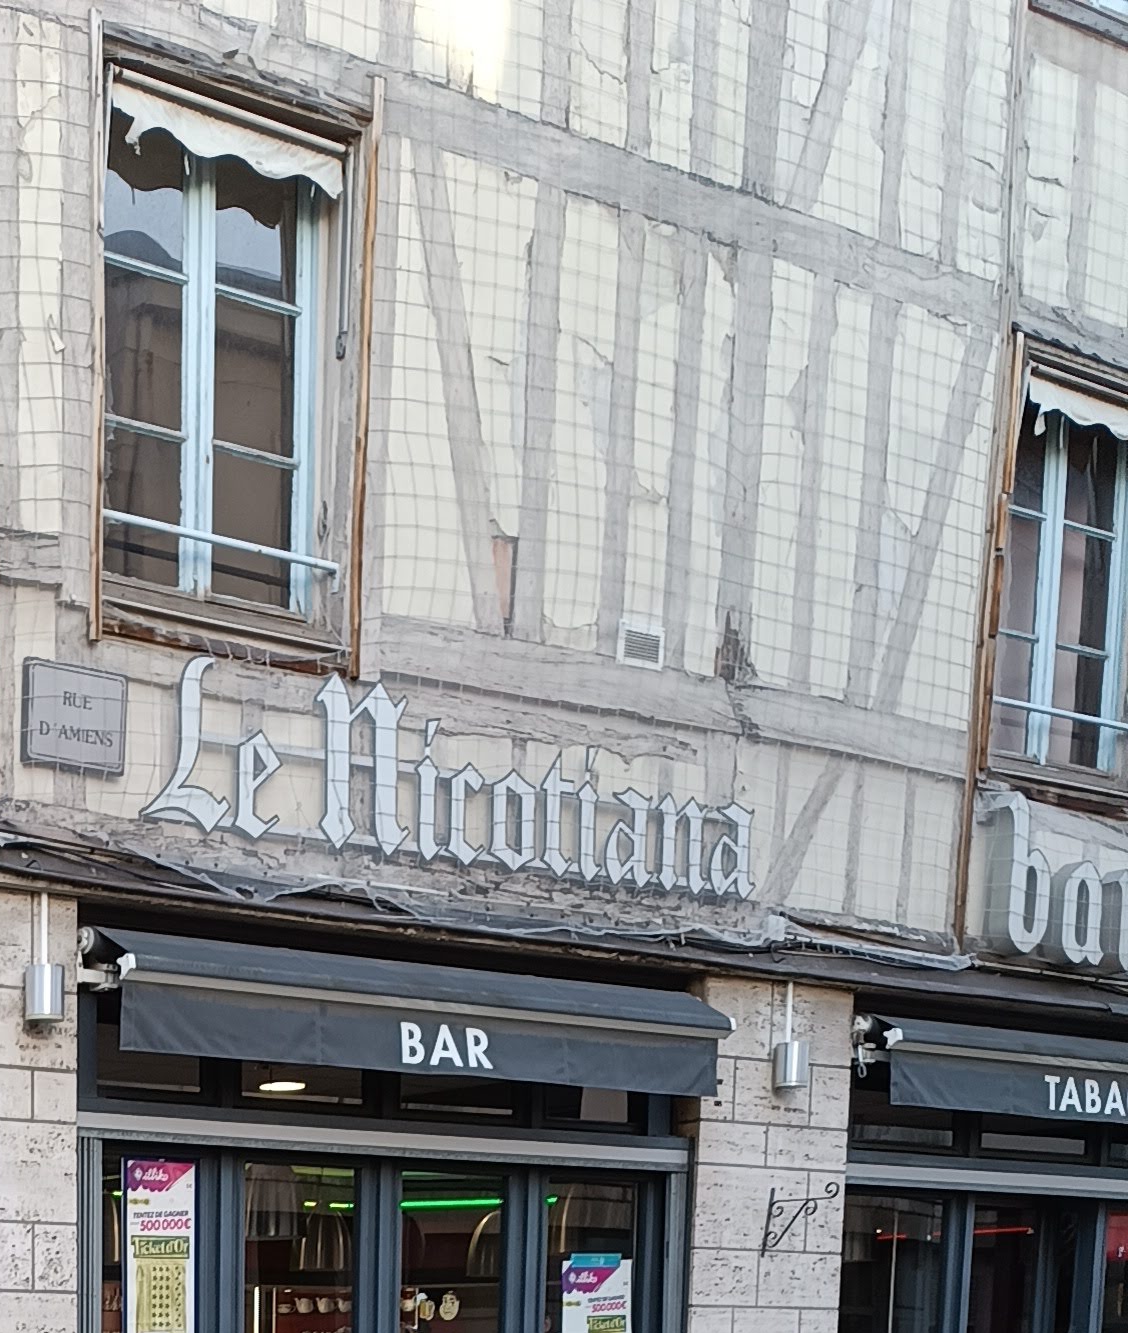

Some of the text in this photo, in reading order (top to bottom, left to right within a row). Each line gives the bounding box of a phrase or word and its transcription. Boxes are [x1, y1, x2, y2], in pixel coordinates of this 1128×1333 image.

[63, 690, 93, 710] RUE
[39, 720, 113, 748] D'AMIENS
[141, 656, 756, 900] Le Nicotiana
[399, 1021, 494, 1070] BAR
[1044, 1074, 1128, 1117] TABA
